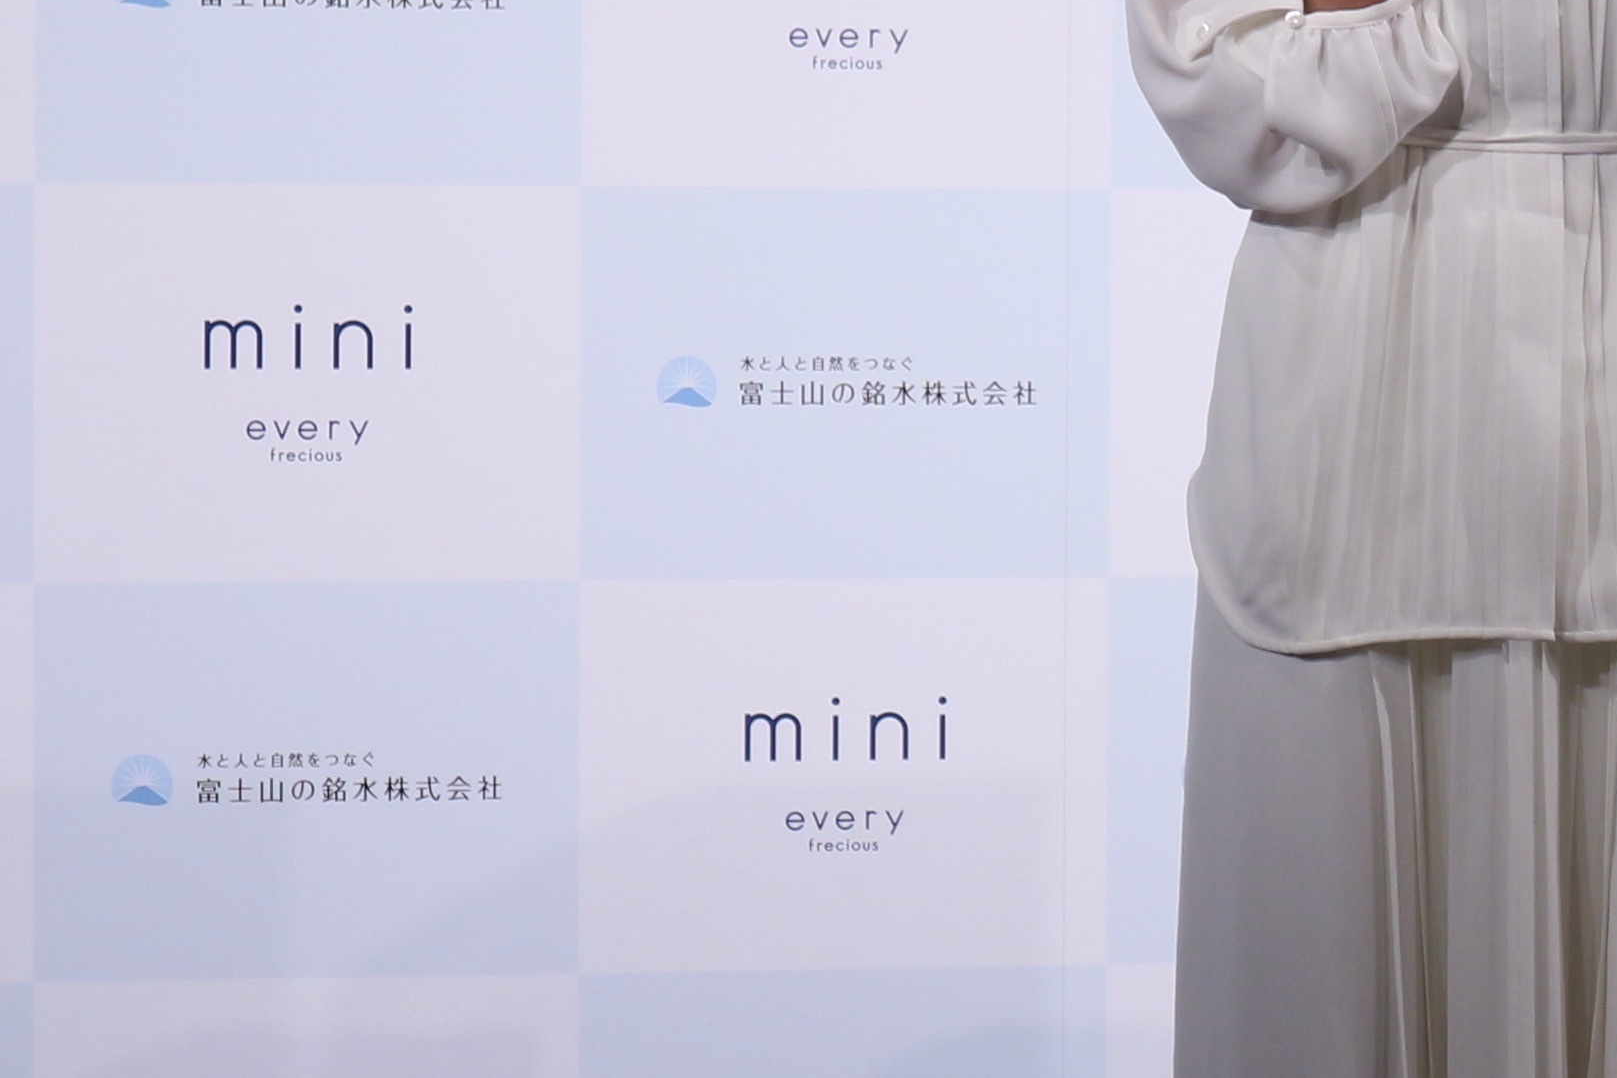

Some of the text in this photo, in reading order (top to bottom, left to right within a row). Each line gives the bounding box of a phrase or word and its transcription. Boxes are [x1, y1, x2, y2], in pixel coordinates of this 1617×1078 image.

[789, 28, 908, 53] every
[812, 55, 882, 70] frecious
[204, 305, 412, 369] mini
[741, 356, 912, 371] 水と人と自然をつなぐ
[740, 381, 1036, 406] 富士山の銘水株式会社
[246, 420, 368, 445] every
[271, 448, 342, 462] frecious
[745, 696, 947, 762] mini
[198, 752, 373, 768] 水と人と自然をつなぐ
[197, 776, 500, 804] 富士山の銘水株式会社
[785, 810, 903, 835] every
[809, 838, 878, 852] frecious
